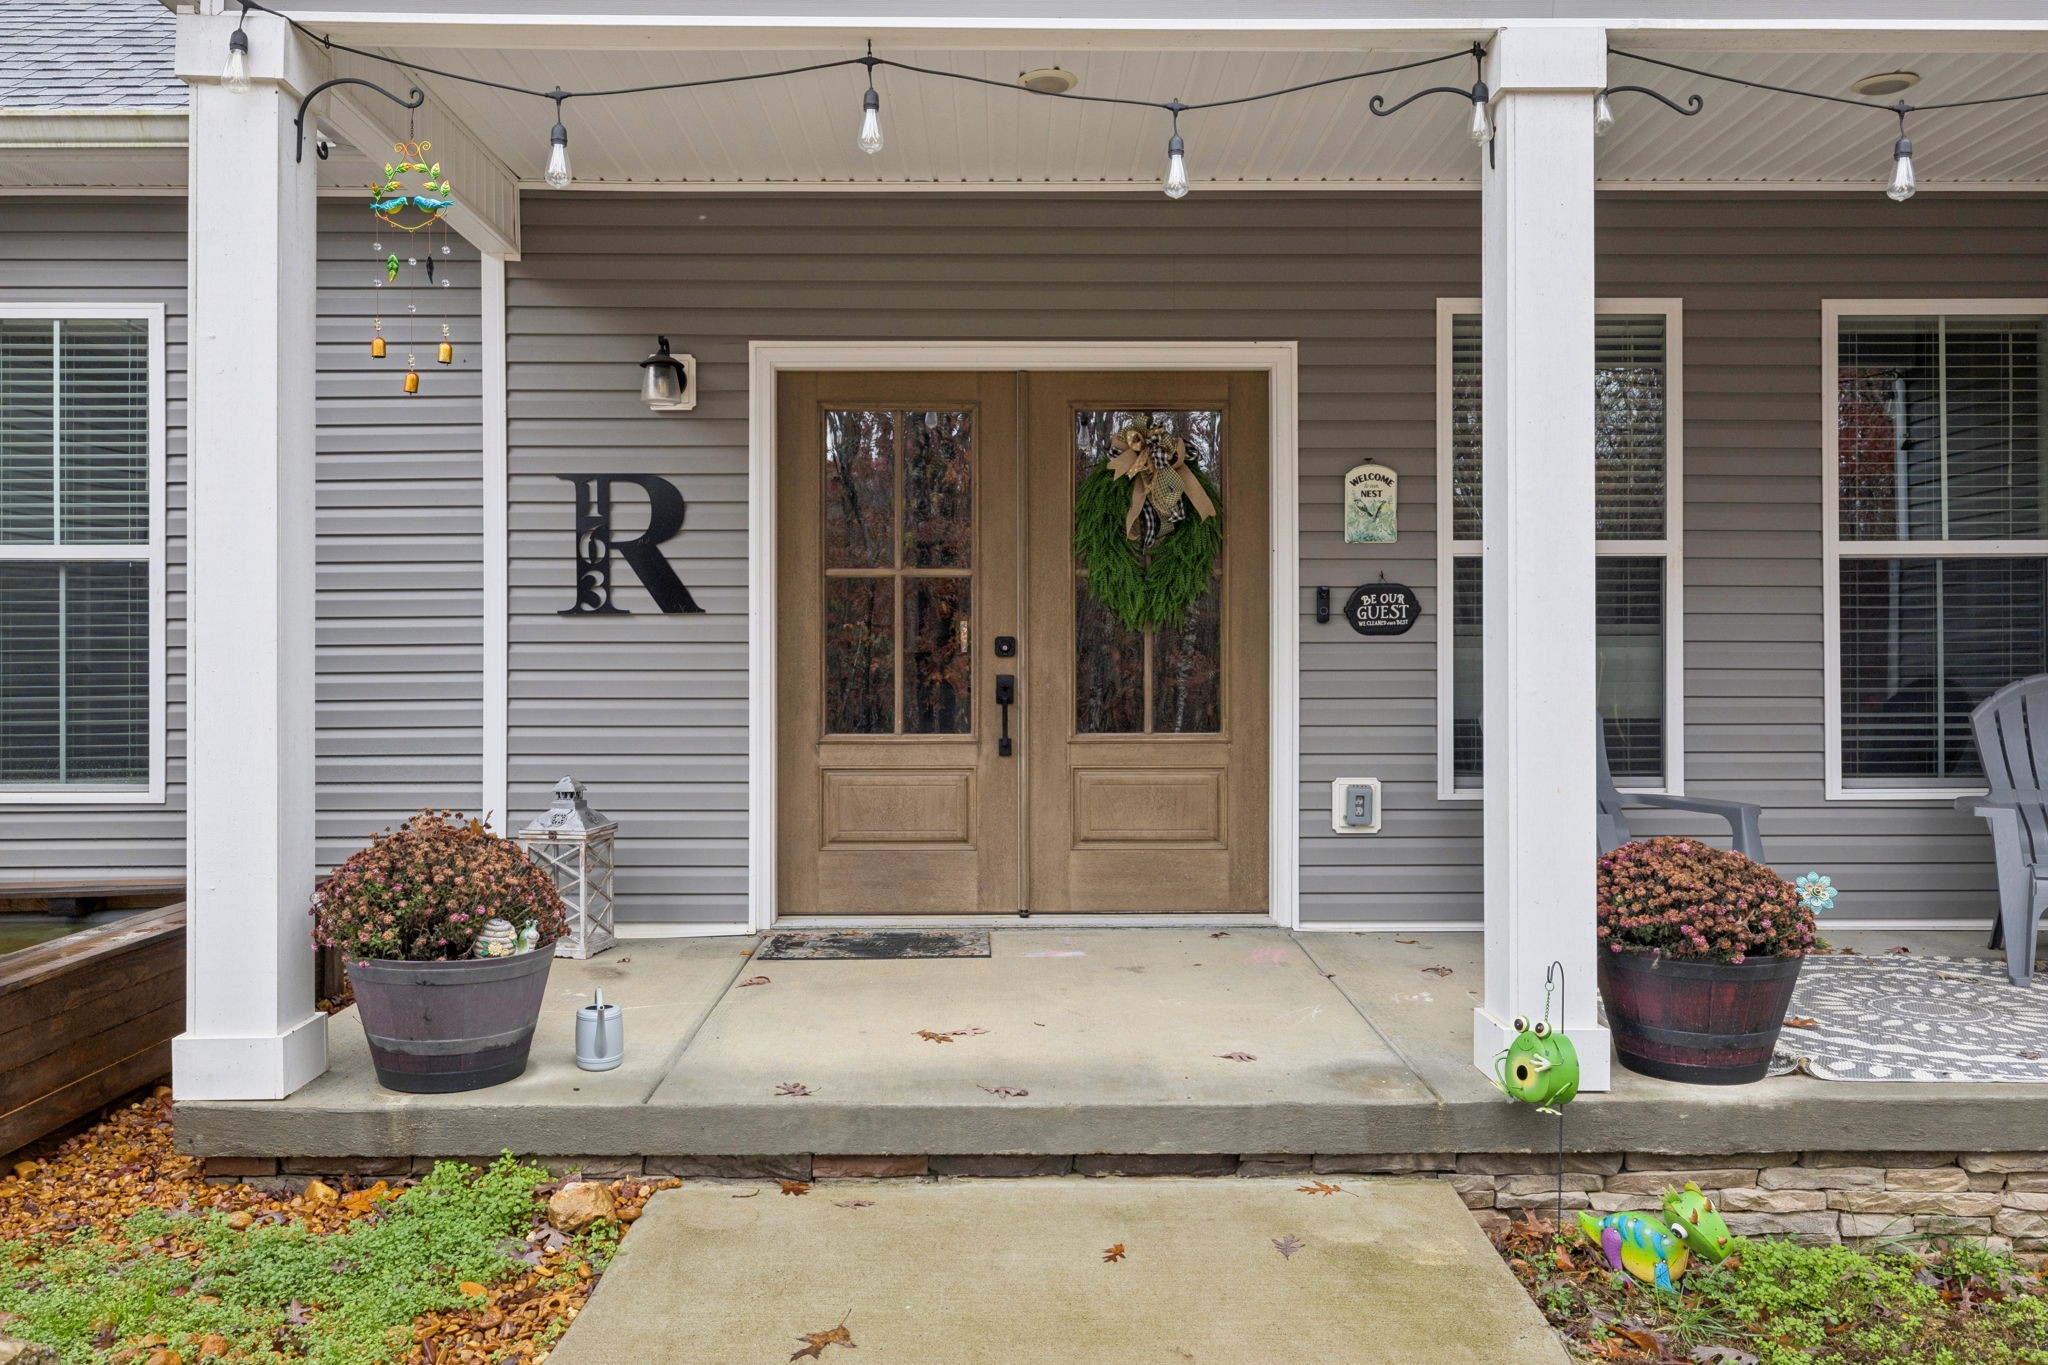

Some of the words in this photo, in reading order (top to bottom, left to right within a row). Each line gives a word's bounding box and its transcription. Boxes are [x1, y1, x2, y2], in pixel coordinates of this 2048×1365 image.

[1349, 472, 1395, 488] WELCOME
[1361, 489, 1383, 498] NEST
[556, 473, 706, 614] R
[579, 479, 607, 611] 163
[1361, 594, 1377, 606] BE
[1380, 593, 1405, 605] OUR
[1357, 604, 1410, 620] GUEST
